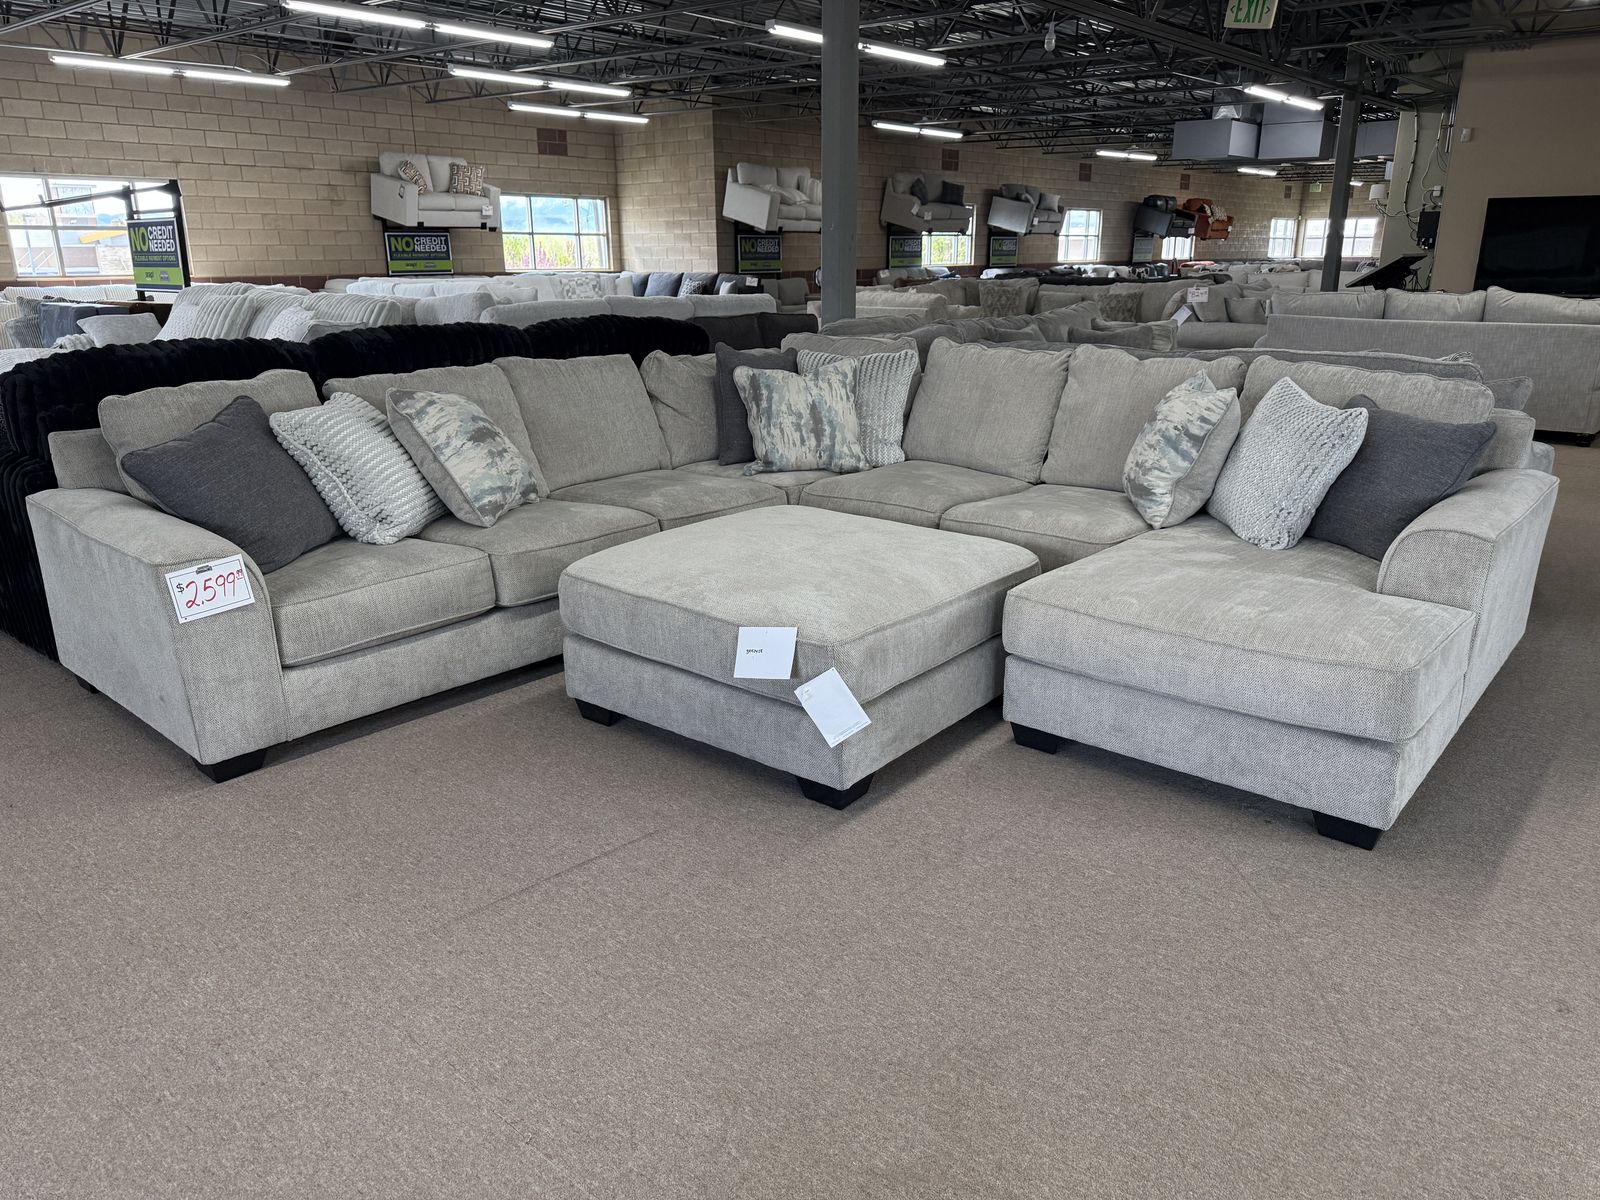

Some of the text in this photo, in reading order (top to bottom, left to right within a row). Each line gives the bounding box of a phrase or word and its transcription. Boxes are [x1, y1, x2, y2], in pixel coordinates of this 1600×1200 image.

[130, 226, 148, 252] NO
[147, 225, 173, 240] CREDIT
[148, 239, 176, 252] NEEDED
[390, 236, 414, 251] NO
[414, 236, 446, 245] CREDIT
[741, 239, 757, 252] NO
[414, 244, 447, 252] NEEDED
